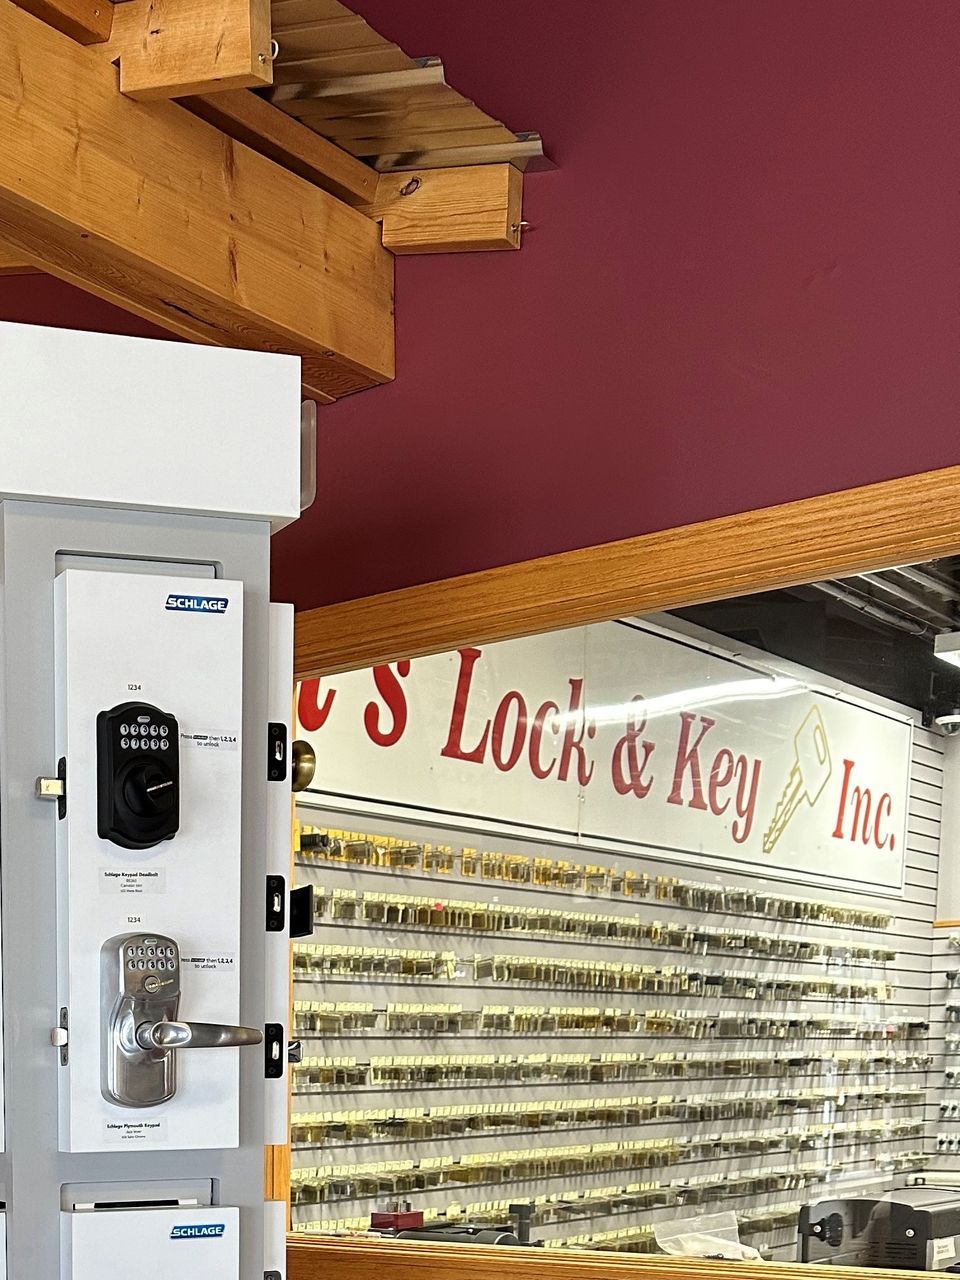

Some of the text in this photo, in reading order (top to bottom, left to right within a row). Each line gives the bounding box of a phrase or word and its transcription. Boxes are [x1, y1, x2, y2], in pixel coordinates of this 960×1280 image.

[165, 597, 227, 611] SCHLAGE
[440, 648, 595, 787] Lock
[611, 694, 656, 799] &
[667, 711, 762, 843] Key
[832, 758, 896, 851] Inc.
[171, 1226, 224, 1239] SCHLAGE
